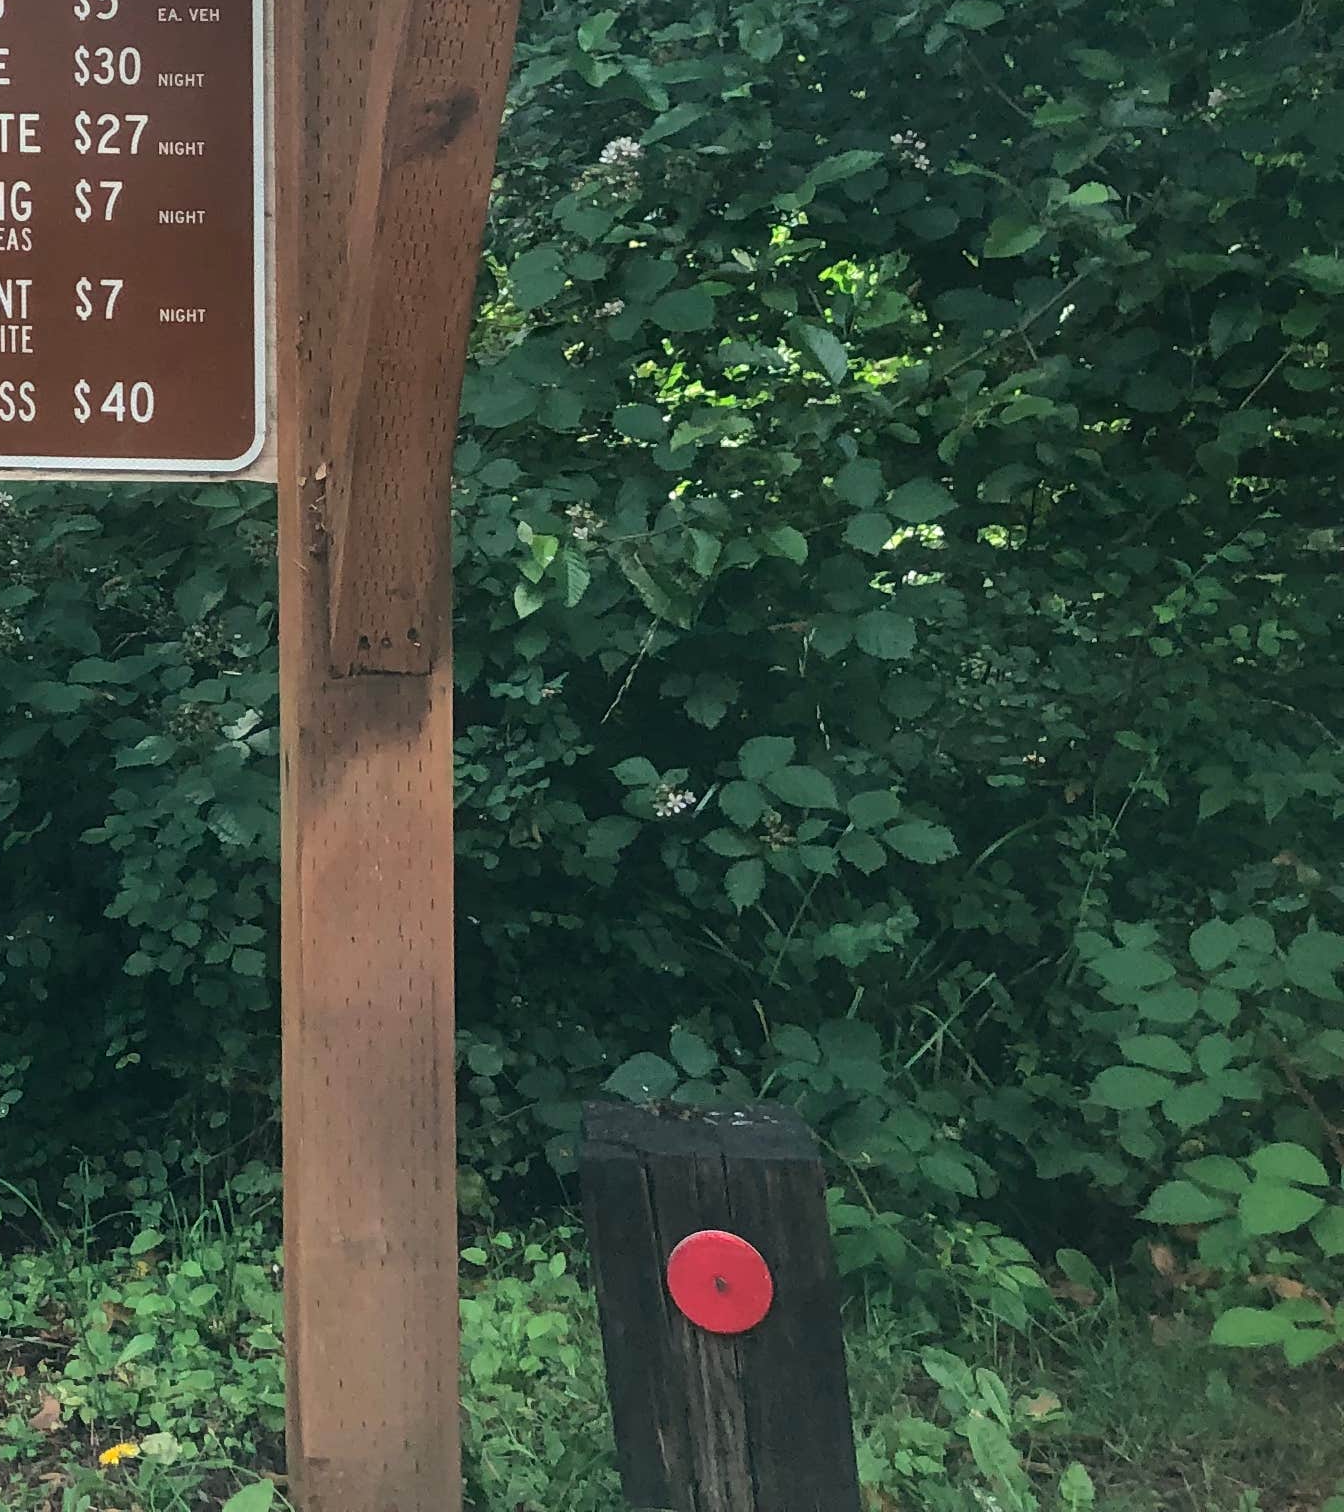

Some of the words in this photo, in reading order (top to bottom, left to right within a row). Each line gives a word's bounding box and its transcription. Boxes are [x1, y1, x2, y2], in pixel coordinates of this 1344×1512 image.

[158, 8, 182, 23] EA.
[190, 8, 219, 23] VEH
[74, 46, 141, 86] $30
[159, 73, 204, 87] NIGHT
[75, 110, 149, 155] $27
[159, 142, 204, 156] NIGHT
[75, 180, 123, 222] $7
[159, 210, 205, 225] NIGHT
